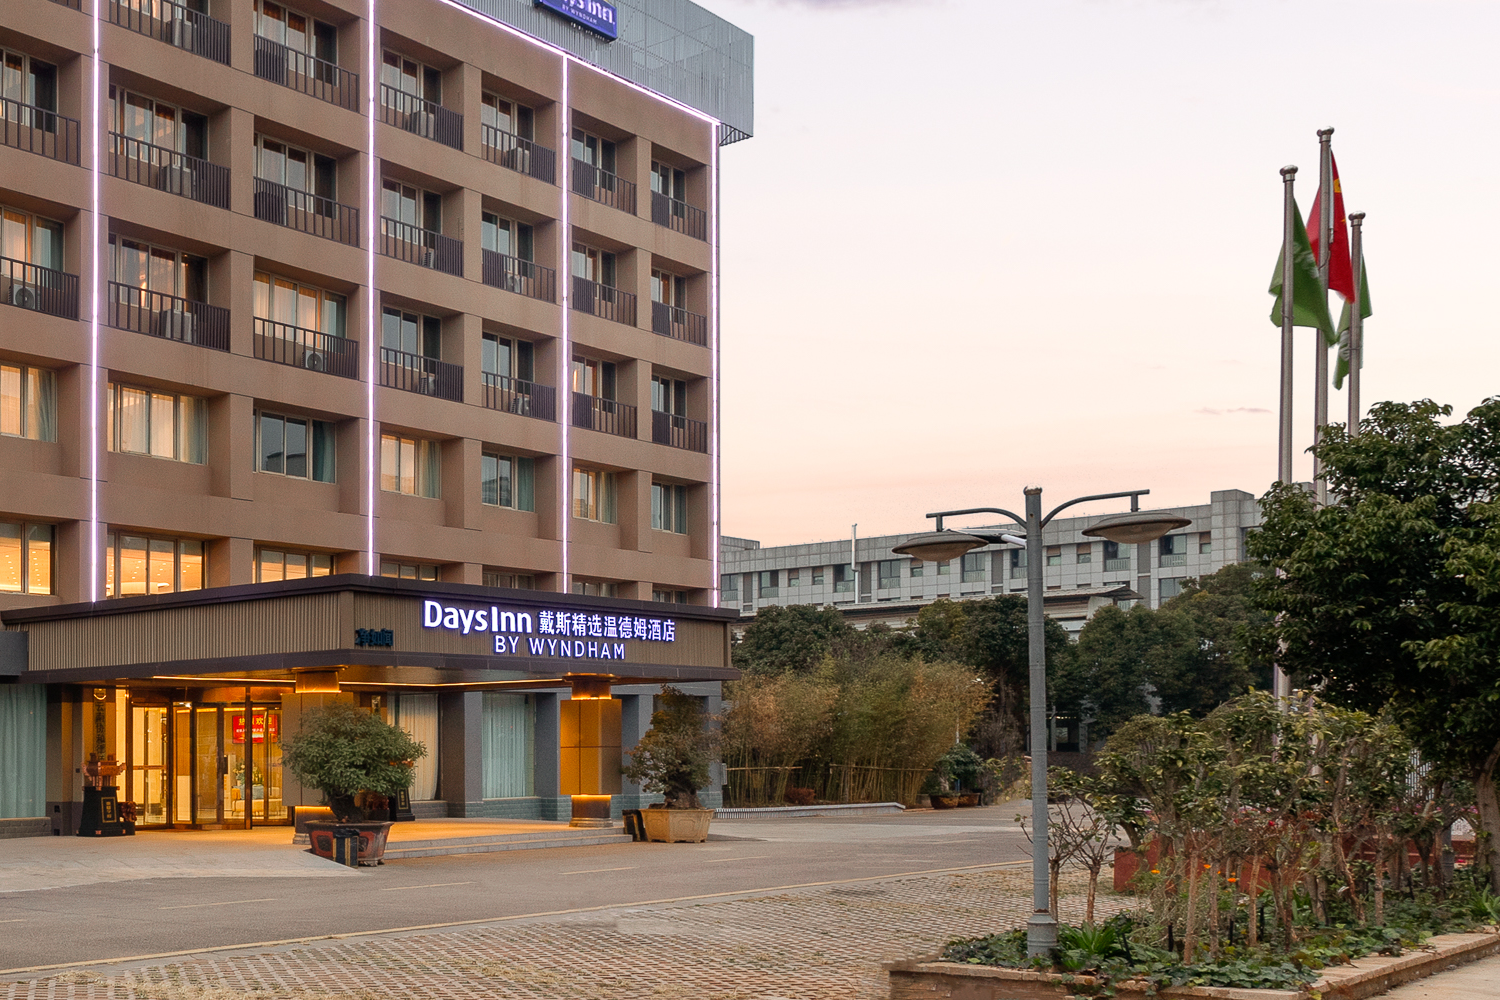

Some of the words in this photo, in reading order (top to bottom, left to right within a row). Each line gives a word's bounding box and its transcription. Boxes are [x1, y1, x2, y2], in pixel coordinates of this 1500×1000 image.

[571, 8, 598, 25] WYNDHAM
[538, 610, 676, 642] 戴斯精选温德姆酒店
[494, 635, 520, 654] BY
[528, 638, 625, 660] WYNDHAM
